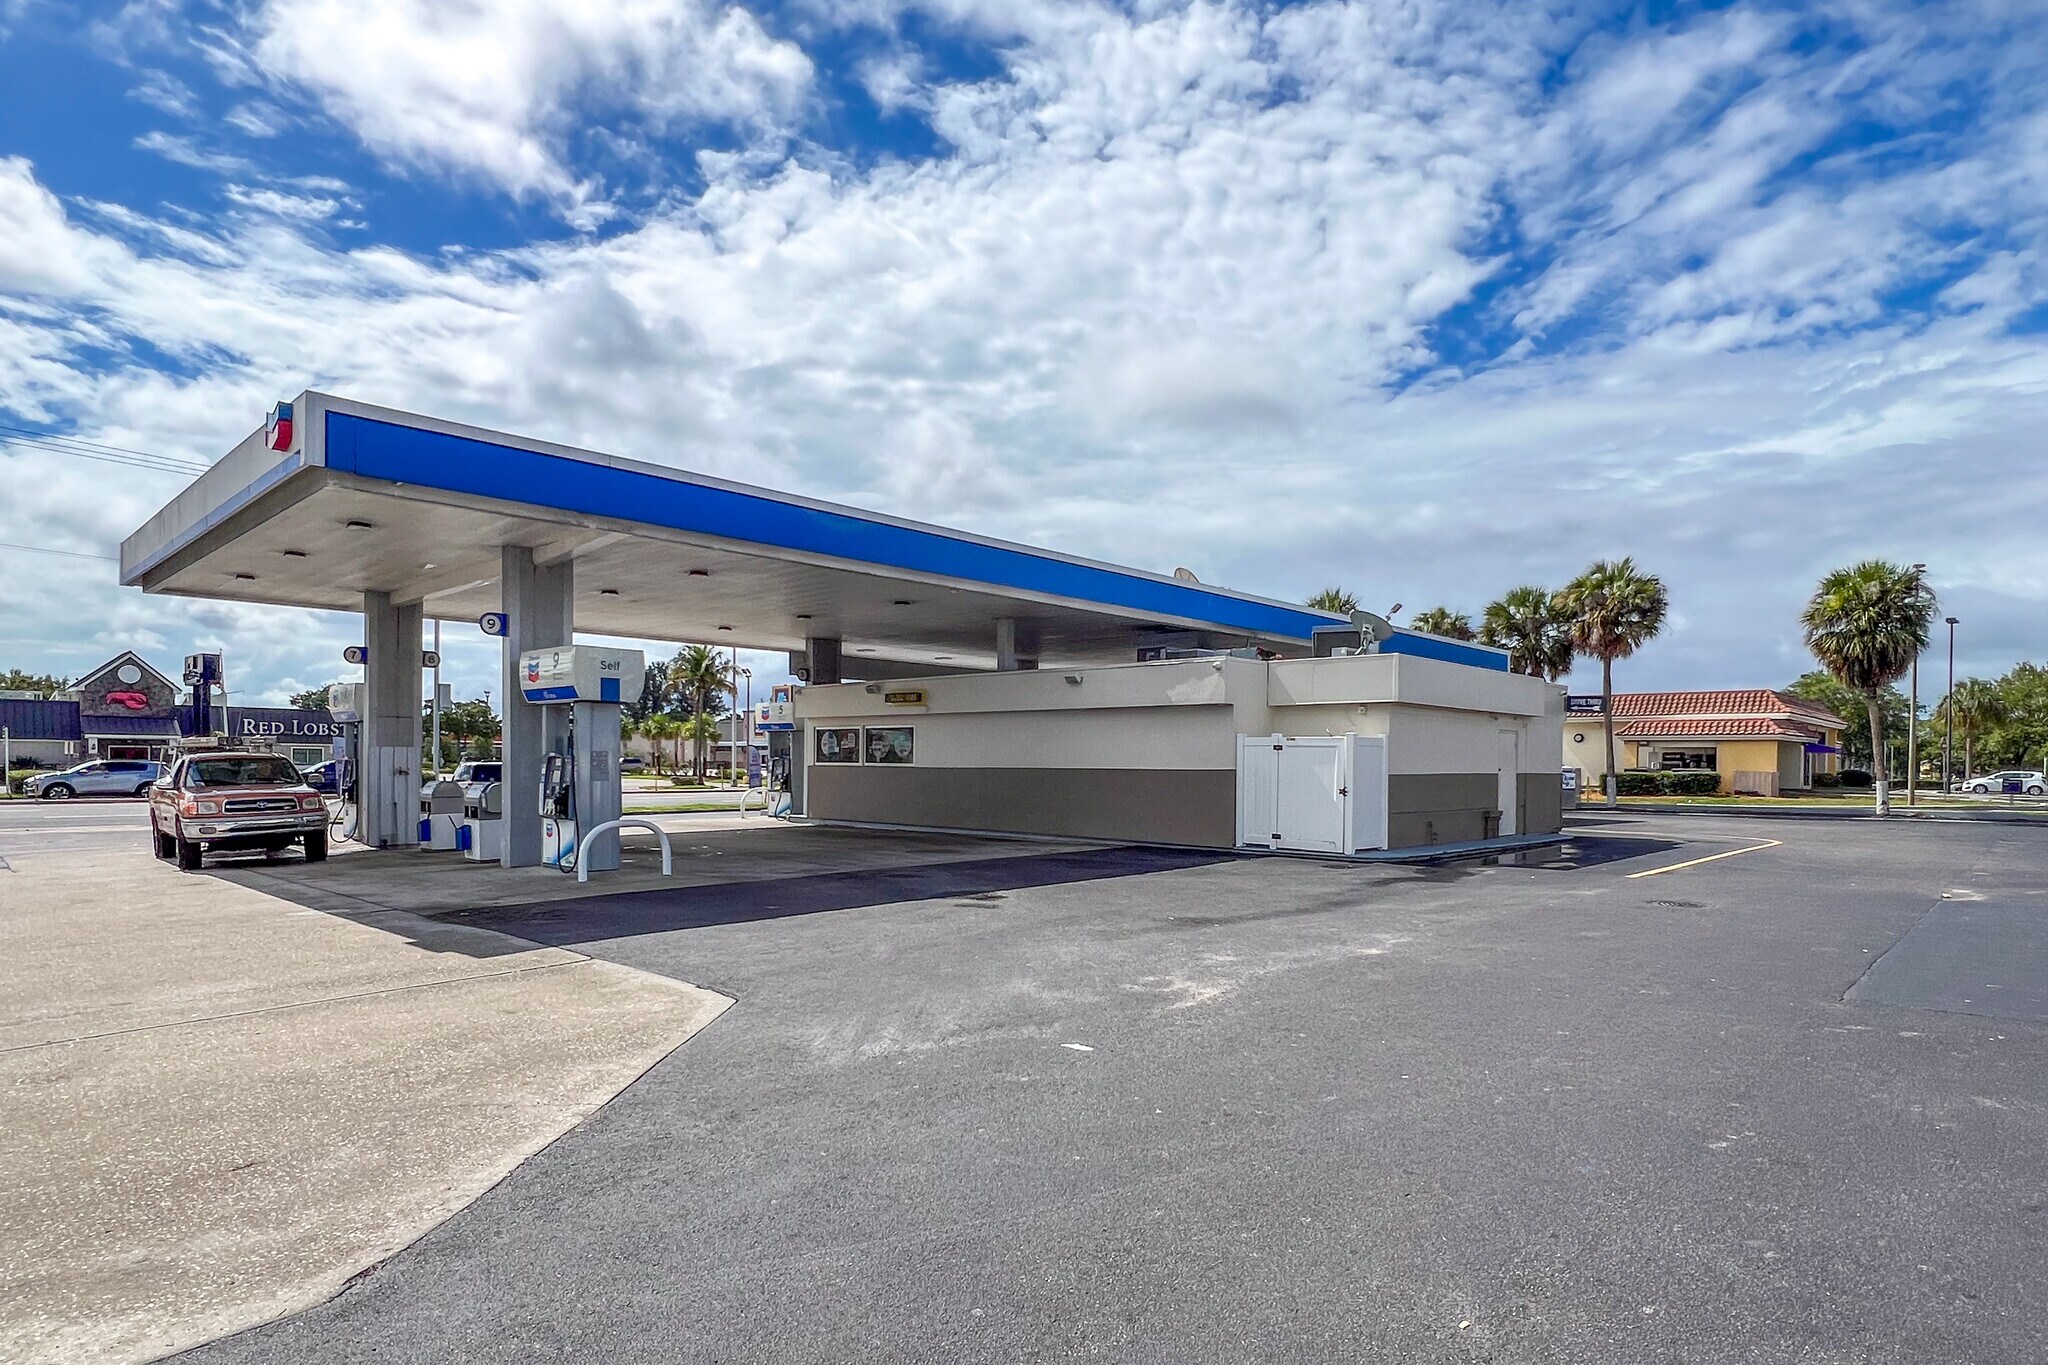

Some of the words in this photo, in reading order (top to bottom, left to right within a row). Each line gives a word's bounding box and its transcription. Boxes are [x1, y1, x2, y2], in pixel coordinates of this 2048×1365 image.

[487, 618, 496, 629] 9
[350, 650, 357, 659] 7
[553, 652, 560, 669] 9
[600, 660, 620, 671] Self
[778, 705, 784, 714] 5
[242, 718, 285, 734] RED
